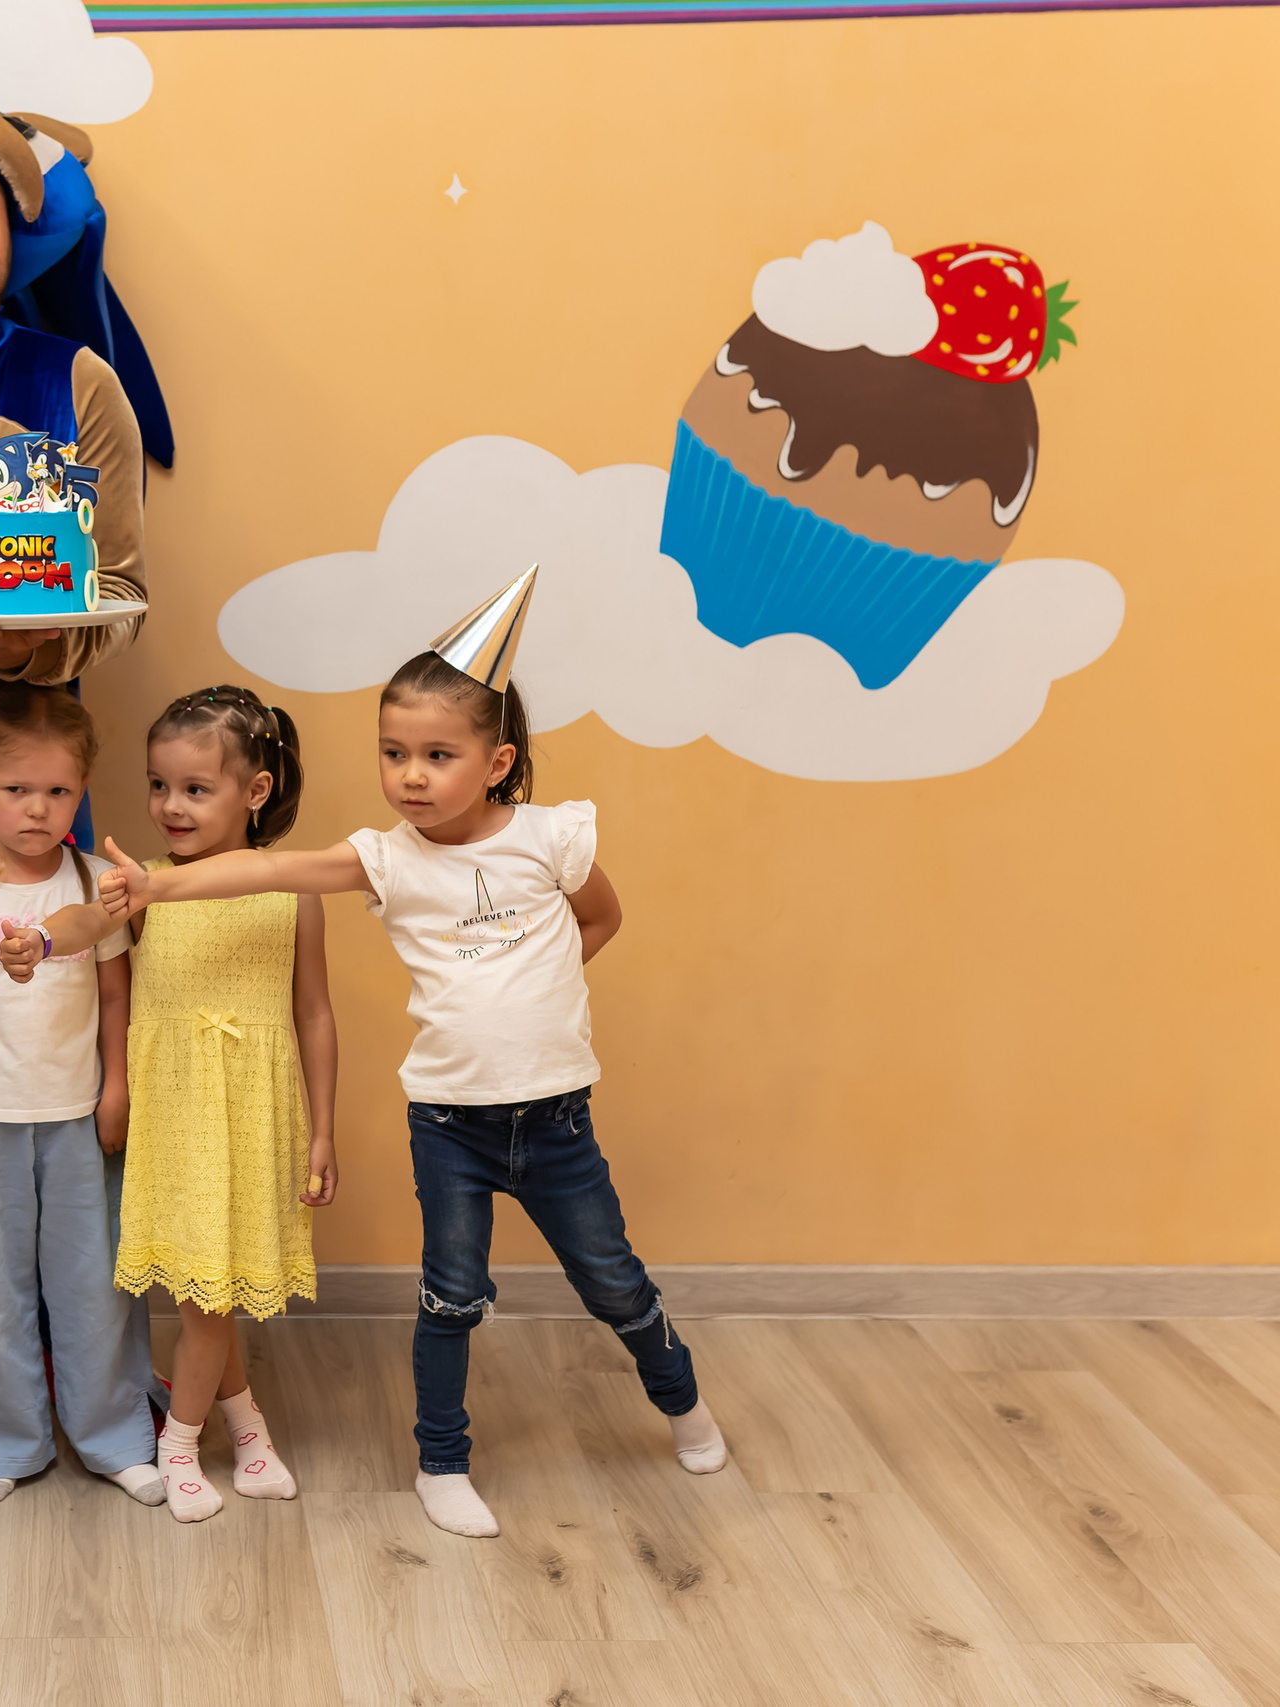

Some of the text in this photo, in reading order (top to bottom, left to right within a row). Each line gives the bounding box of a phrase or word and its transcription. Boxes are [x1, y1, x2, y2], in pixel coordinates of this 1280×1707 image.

[60, 464, 101, 511] 5
[463, 912, 503, 927] BELIEVE
[505, 909, 516, 917] IN
